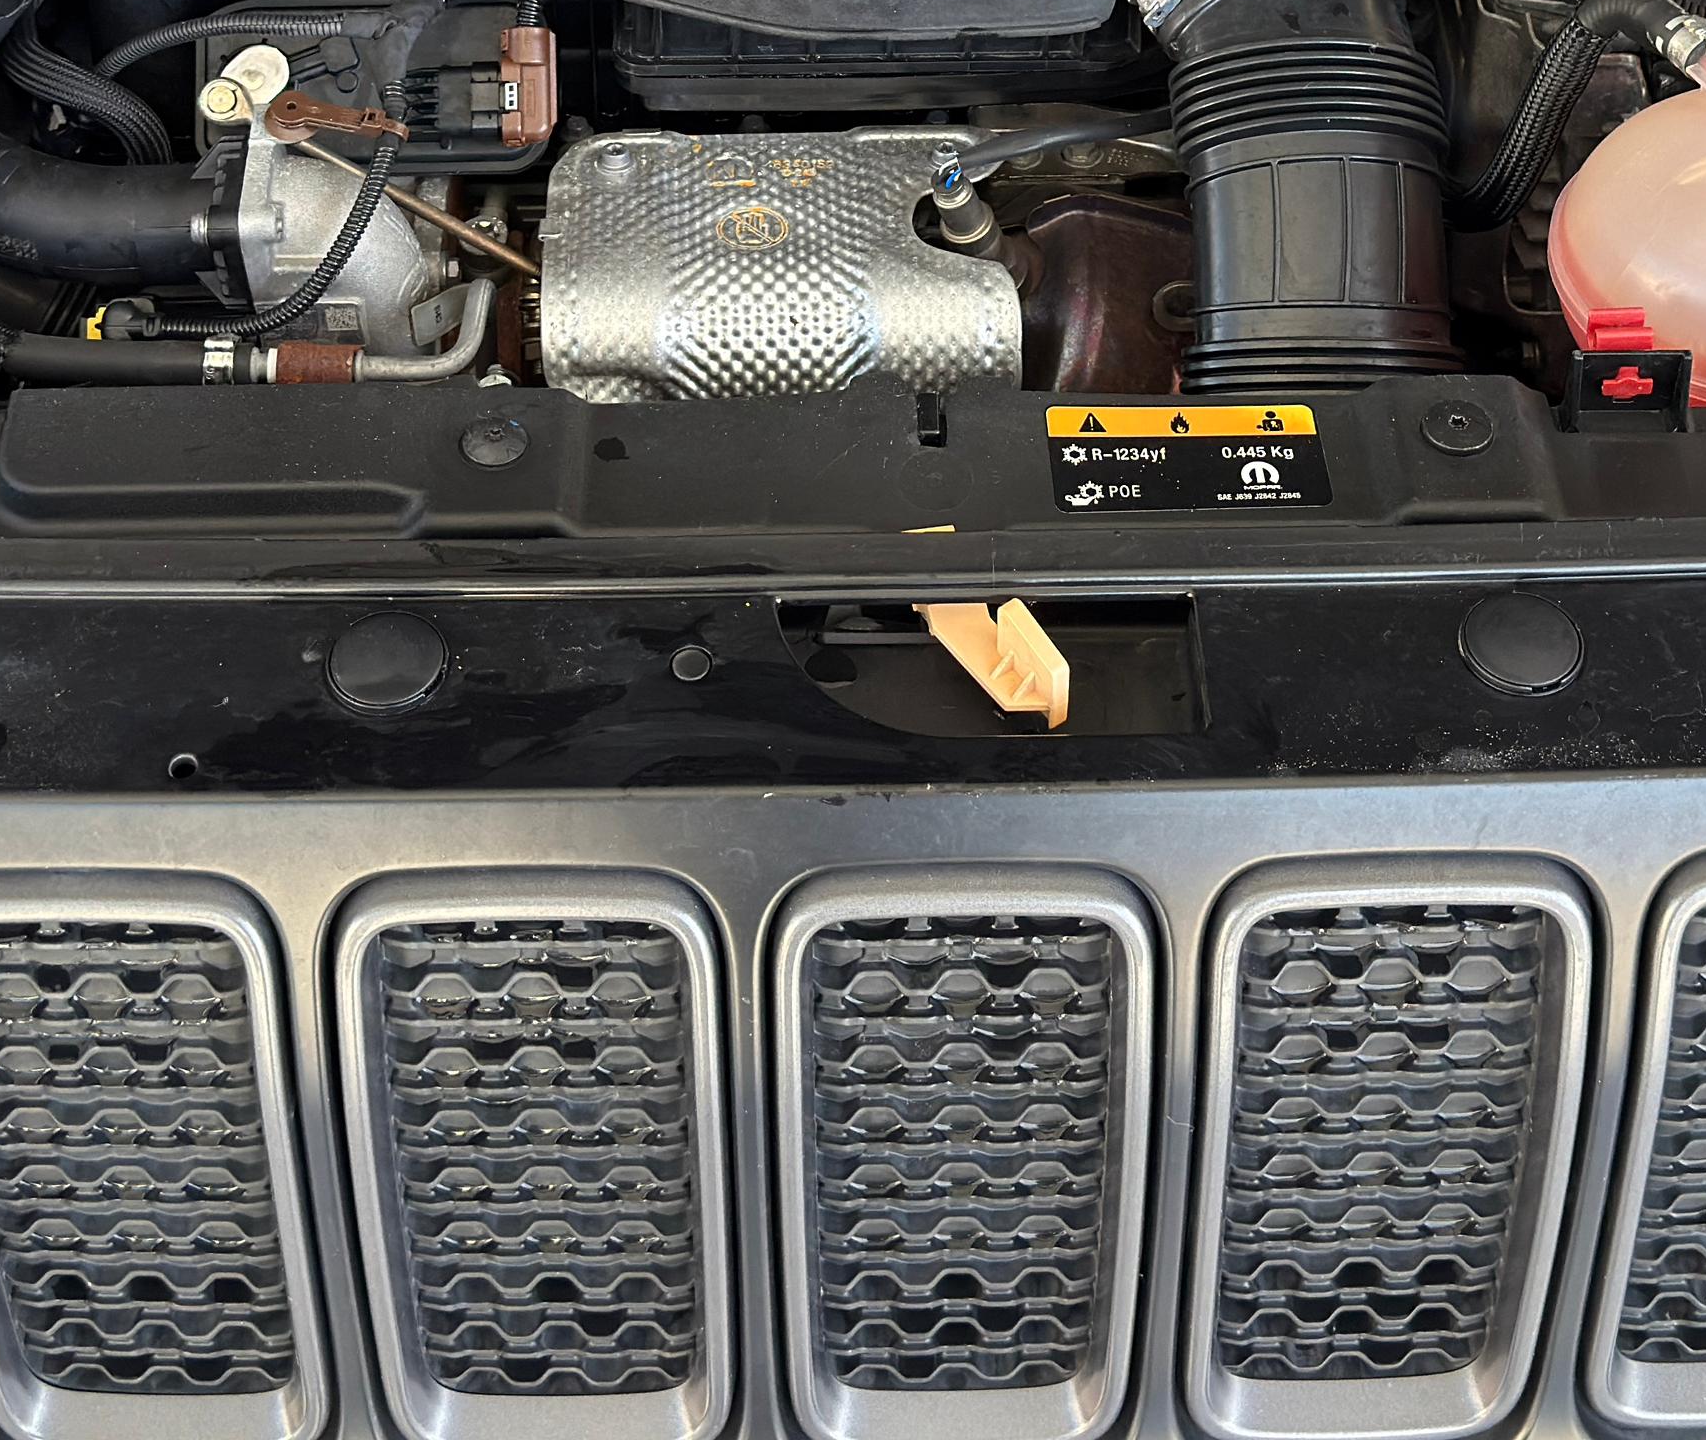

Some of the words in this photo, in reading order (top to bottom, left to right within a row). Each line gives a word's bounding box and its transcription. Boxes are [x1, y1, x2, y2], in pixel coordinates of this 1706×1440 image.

[1092, 447, 1166, 463] R-1234yf
[1221, 446, 1267, 460] 0.445
[1270, 445, 1294, 461] Kg
[1108, 485, 1142, 499] POE
[1217, 493, 1232, 501] SAE
[1234, 492, 1253, 501] J639
[1254, 492, 1277, 500] J2842
